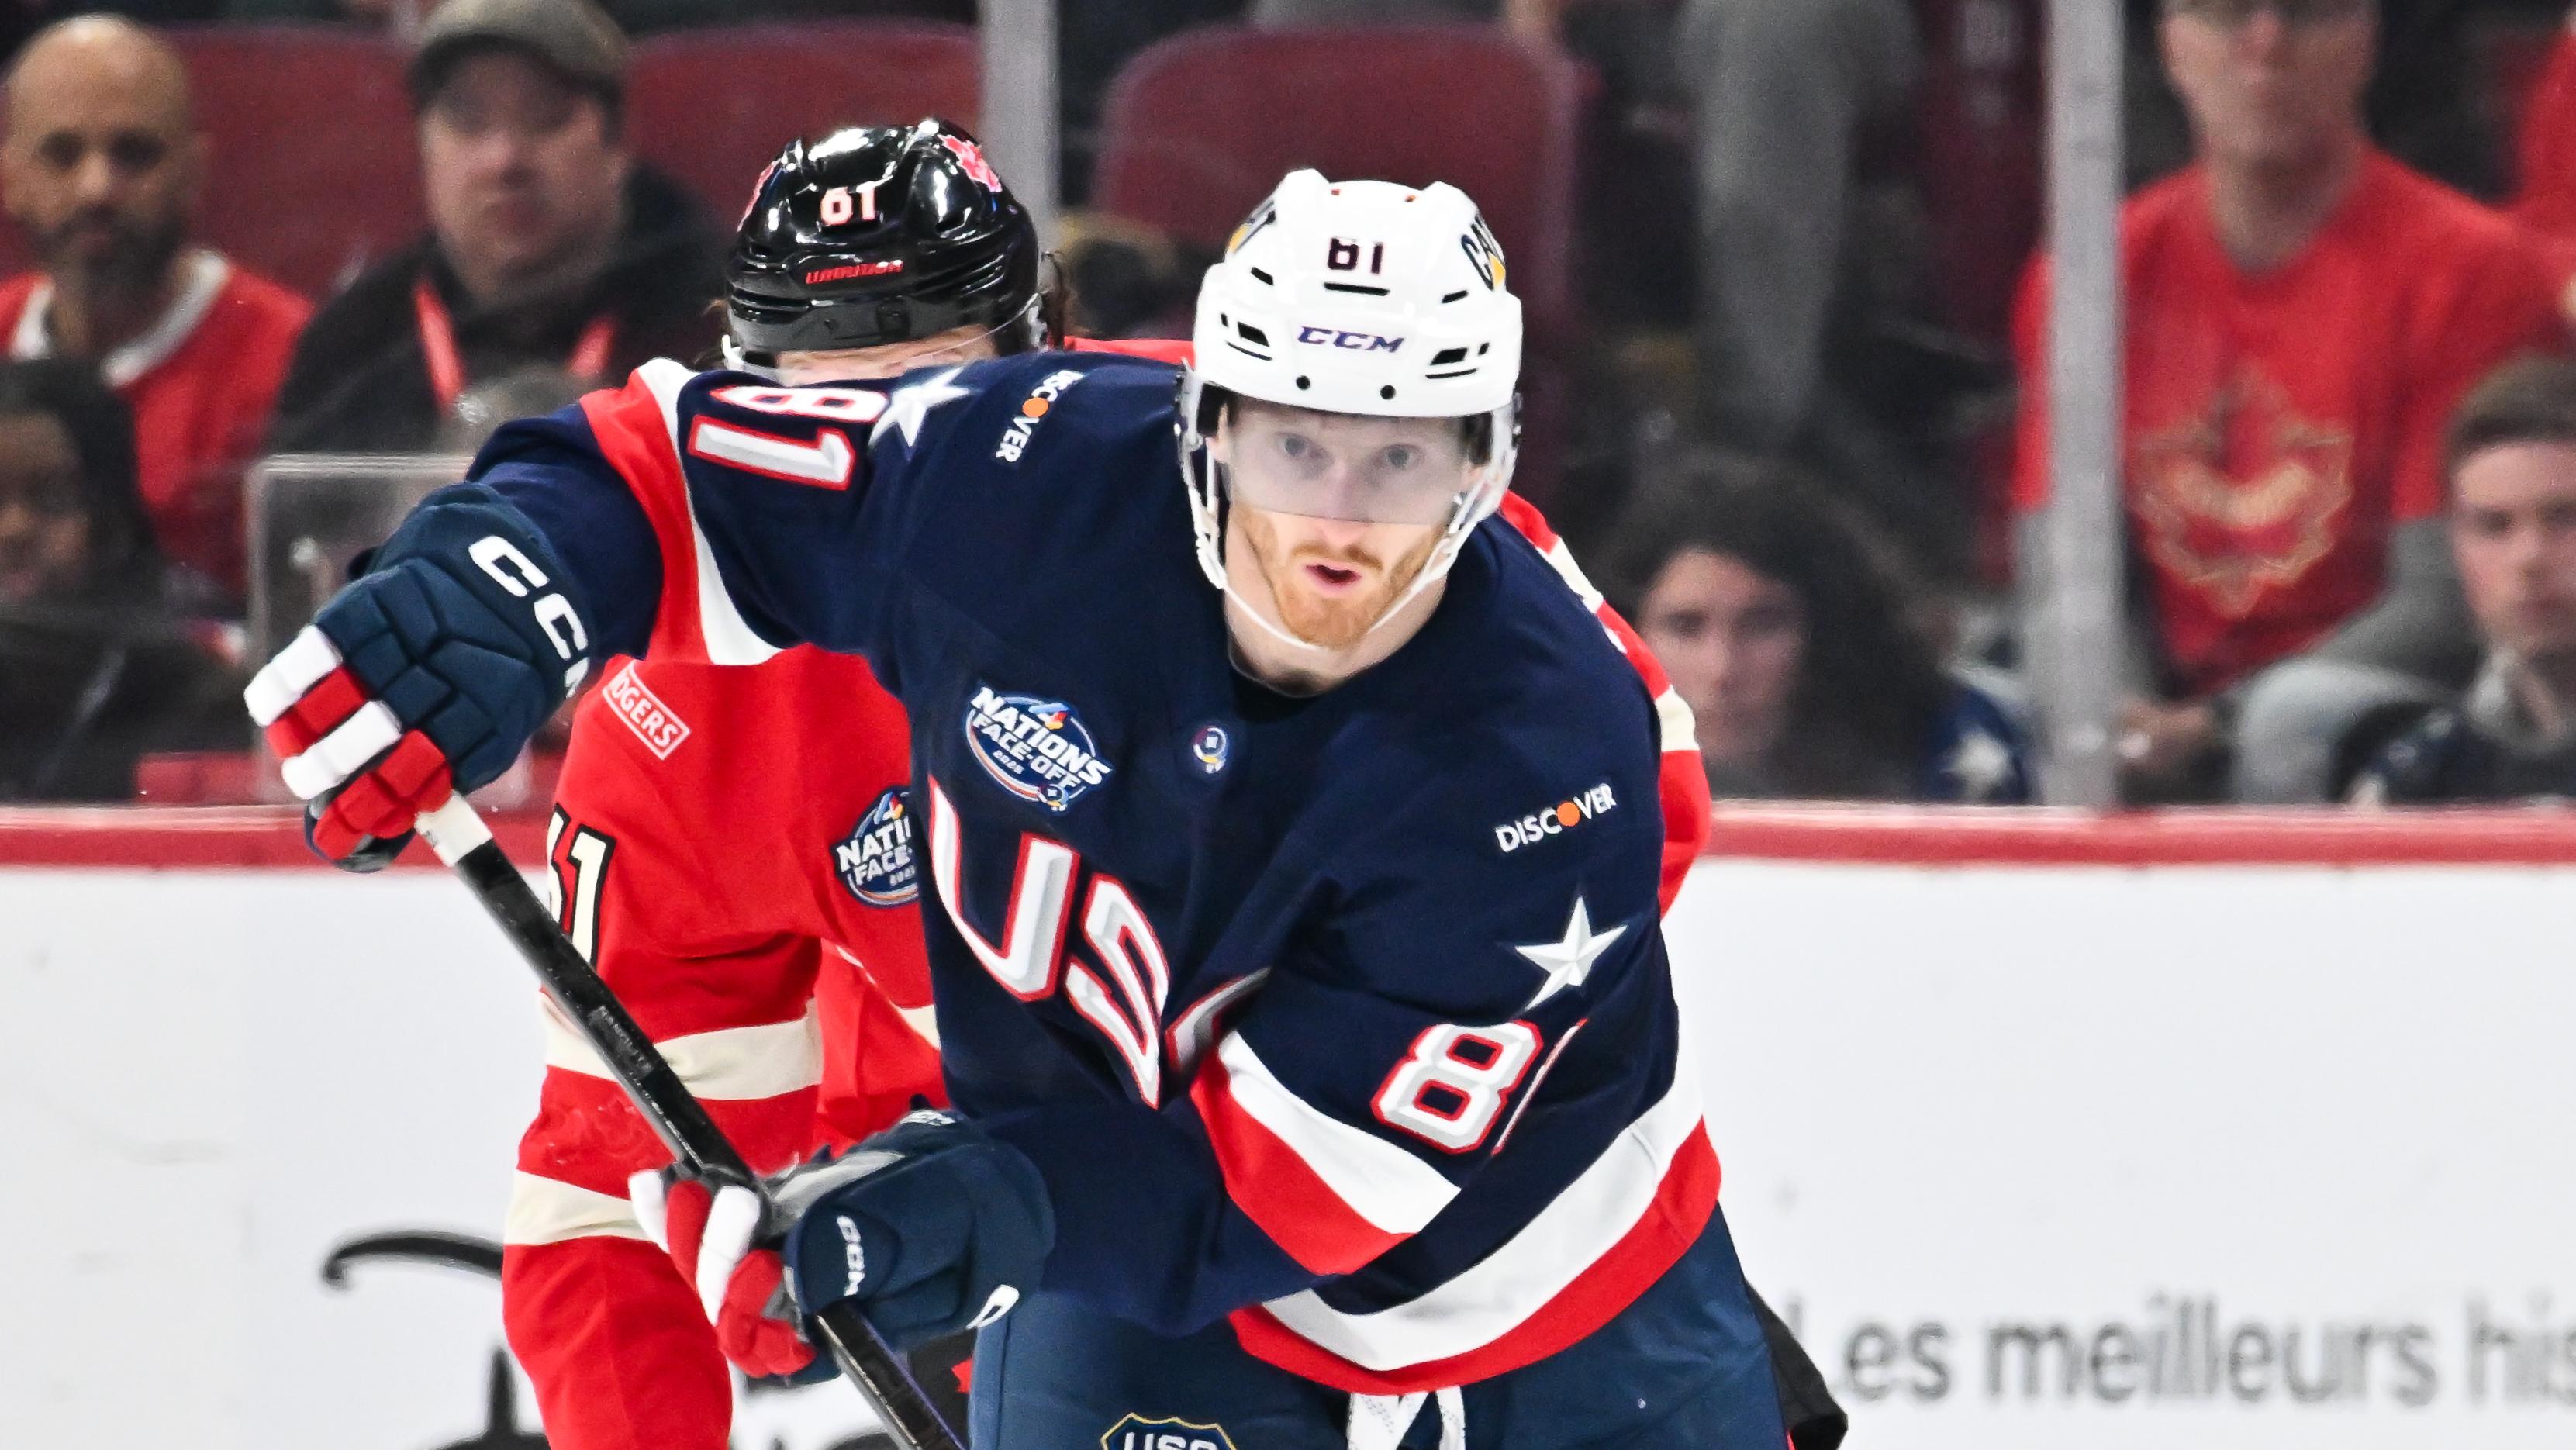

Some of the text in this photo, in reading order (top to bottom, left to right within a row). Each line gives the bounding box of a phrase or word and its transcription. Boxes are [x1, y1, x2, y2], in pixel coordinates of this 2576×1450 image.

[820, 186, 879, 226] 61
[1297, 326, 1405, 353] CCM
[688, 384, 889, 491] 81
[970, 685, 1112, 786] NATIONS
[972, 712, 1086, 791] FACE-OFF
[836, 815, 913, 873] NATI
[1494, 783, 1618, 853] DISCOVER
[928, 773, 1273, 1109] US
[1987, 1289, 2440, 1408] meilleurs
